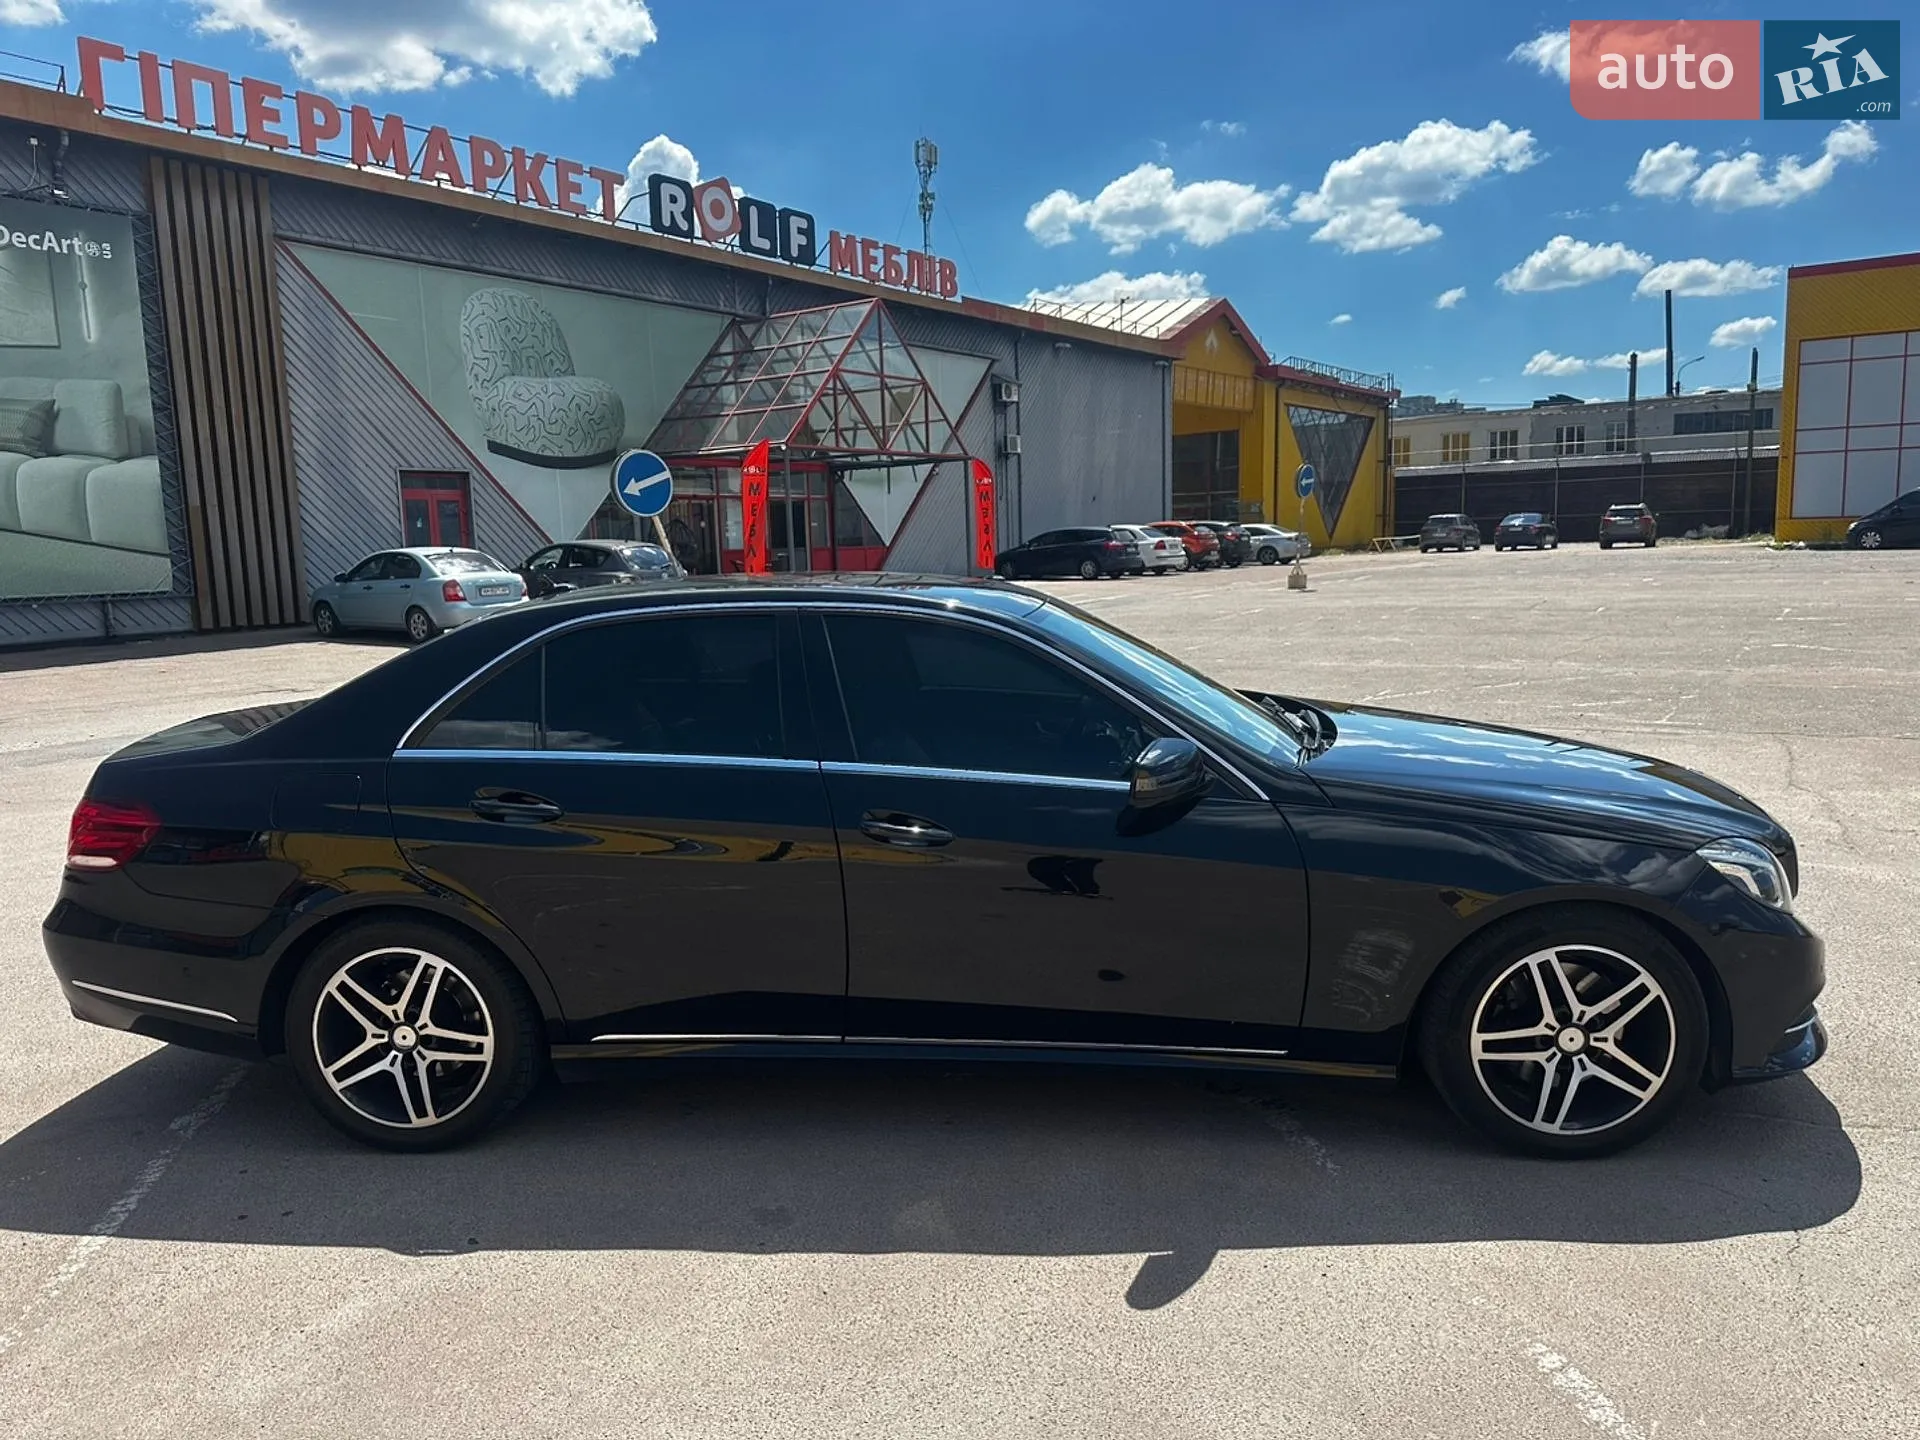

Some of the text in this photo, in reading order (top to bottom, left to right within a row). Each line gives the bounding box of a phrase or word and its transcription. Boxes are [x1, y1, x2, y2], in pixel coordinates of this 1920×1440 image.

[77, 36, 959, 298] ГІПЕРМАРКЕТ ROLF МЕБЛІВ
